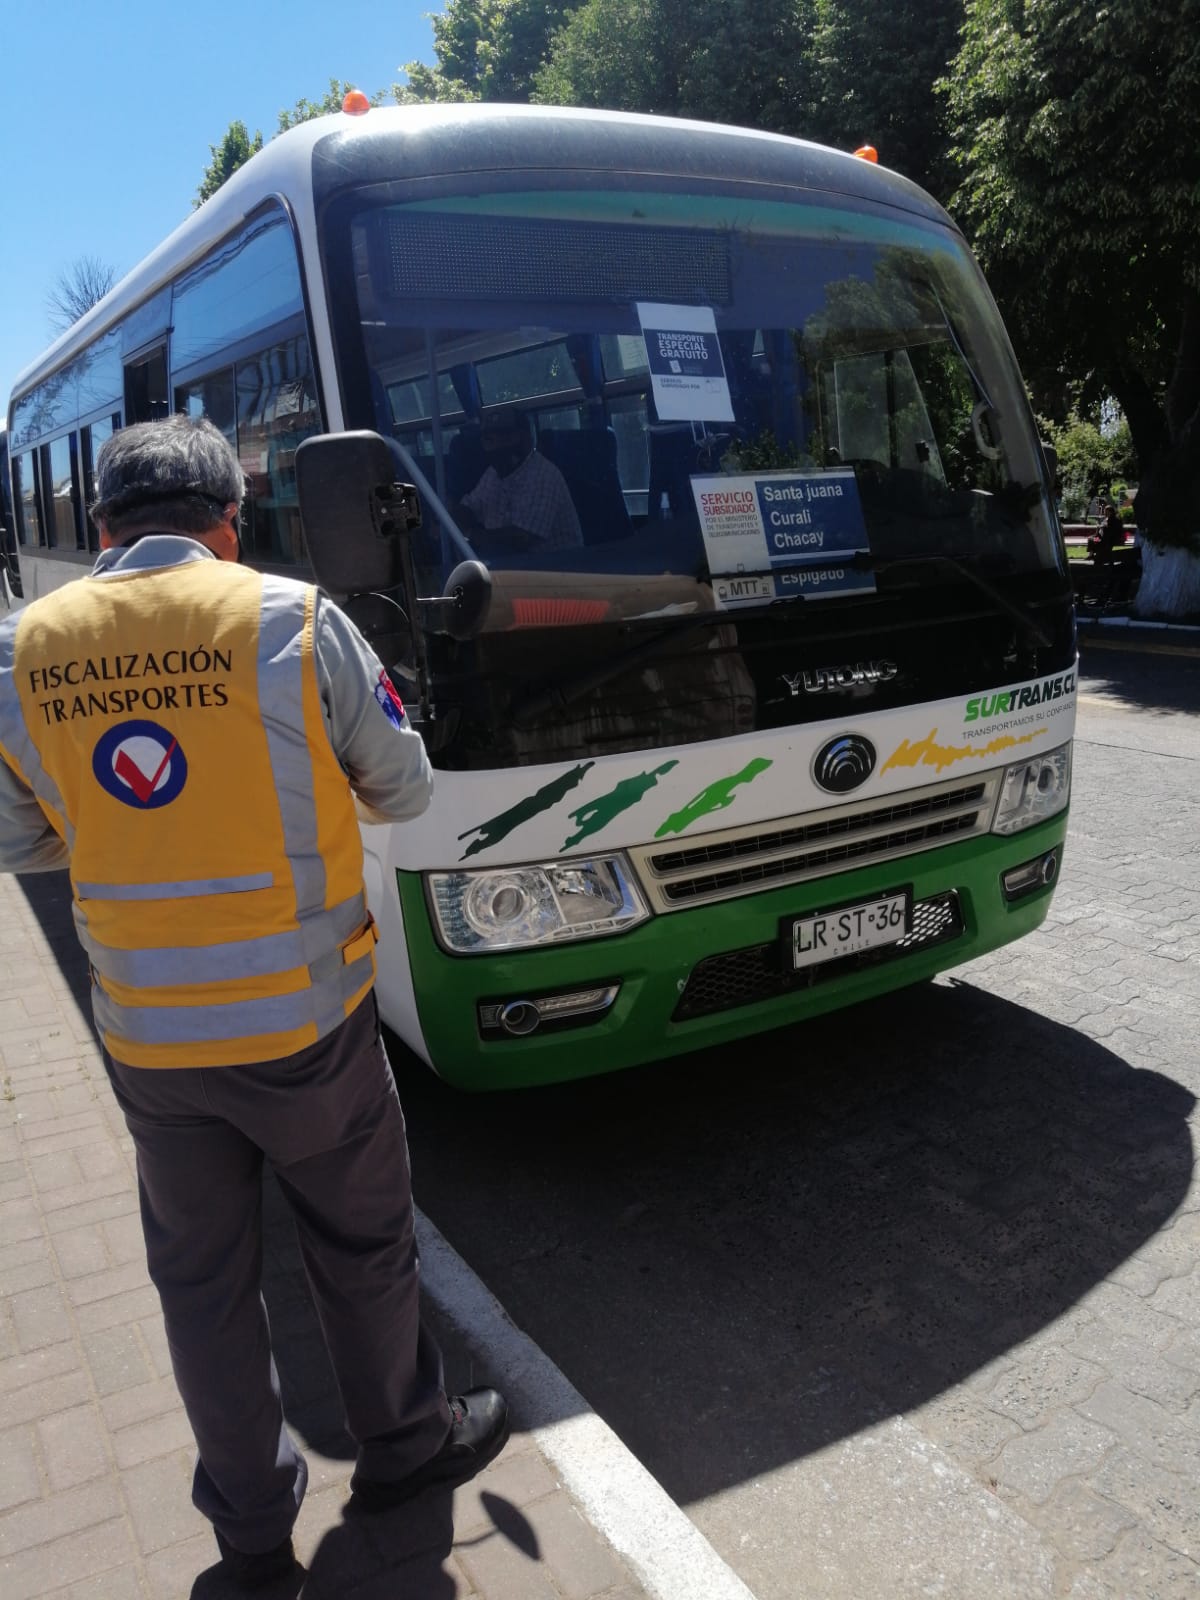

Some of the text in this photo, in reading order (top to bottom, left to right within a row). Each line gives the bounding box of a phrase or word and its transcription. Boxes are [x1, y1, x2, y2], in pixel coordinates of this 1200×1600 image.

[657, 333, 704, 342] TRANSPORTE
[659, 341, 707, 350] ESPECIAL
[660, 350, 708, 359] GRATUITO
[701, 491, 753, 505] SERVICIO
[763, 484, 843, 502] Santa juana
[703, 503, 755, 516] SUBSIDIADO
[770, 509, 812, 526] Curali
[774, 531, 824, 548] Chacay
[730, 580, 758, 596] MTT
[29, 644, 233, 694] FISCALIZACIÓN
[781, 658, 898, 695] YUTONG
[39, 682, 229, 726] TRANSPORTES
[962, 715, 1034, 739] TRANSPORTAMOS
